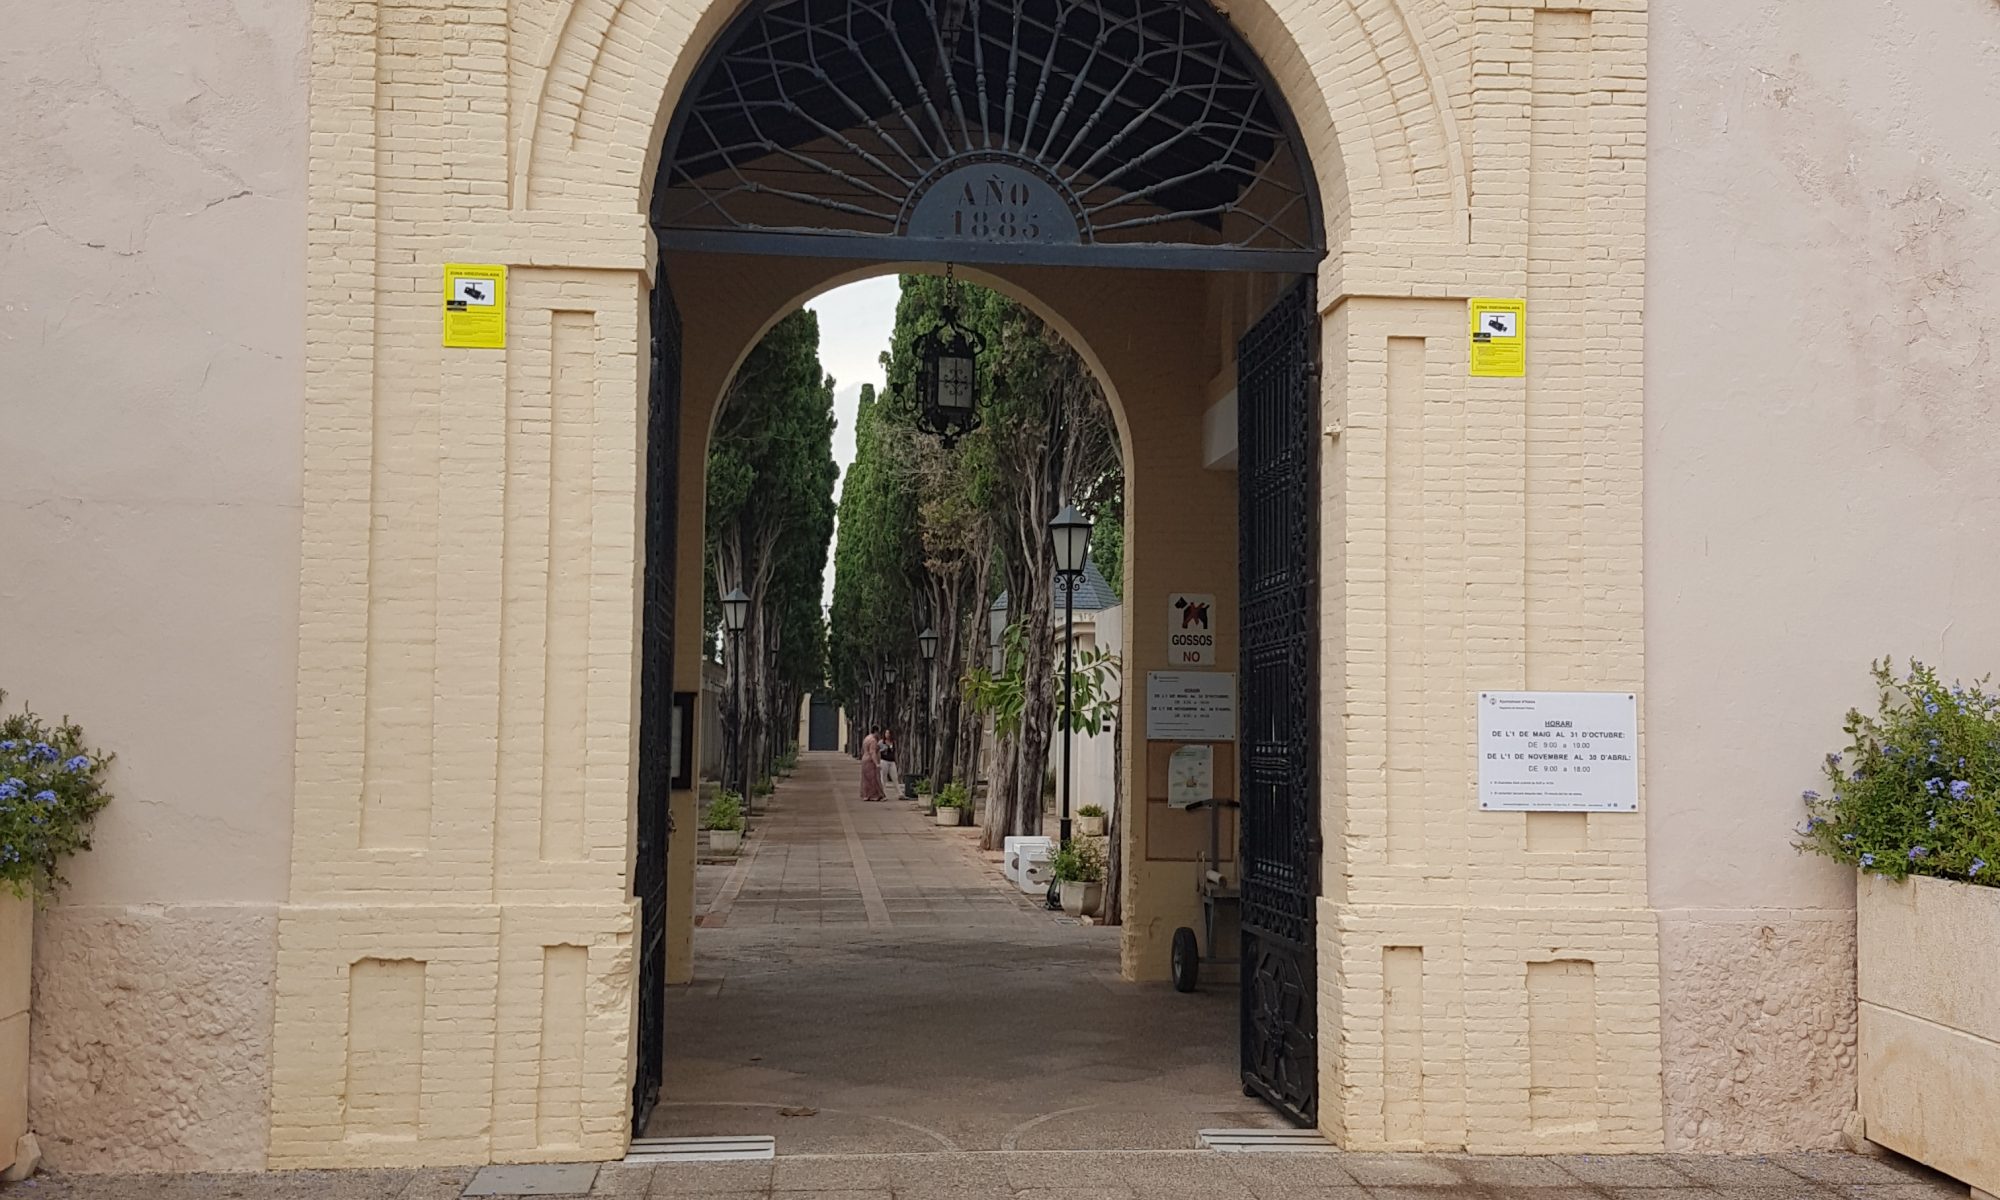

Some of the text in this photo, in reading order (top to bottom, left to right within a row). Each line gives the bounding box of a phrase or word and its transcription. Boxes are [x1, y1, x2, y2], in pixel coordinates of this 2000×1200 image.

[958, 174, 1030, 207] AÑO
[951, 210, 1040, 238] 1885
[1171, 634, 1213, 647] GOSSOS
[1183, 651, 1201, 663] NO
[1544, 720, 1573, 728] HORARI
